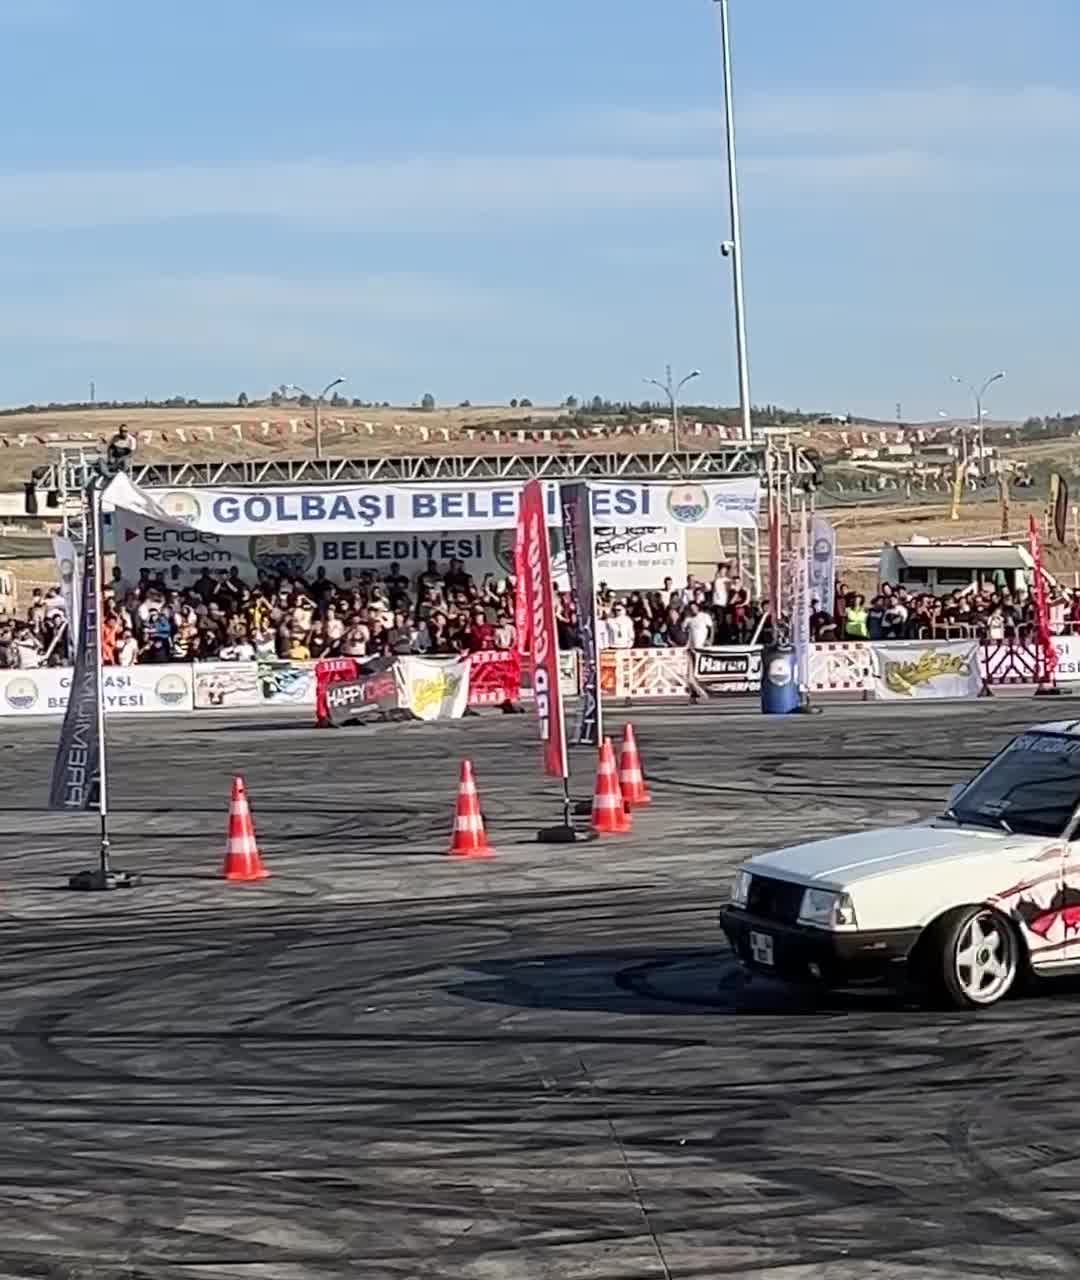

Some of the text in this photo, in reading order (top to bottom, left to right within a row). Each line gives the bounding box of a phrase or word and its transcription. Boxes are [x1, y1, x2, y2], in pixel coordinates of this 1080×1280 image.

[412, 487, 650, 520] BELEİESİ
[144, 547, 232, 561] Reklam
[322, 535, 483, 560] BELEDİYESİ
[327, 684, 365, 708] HAPPY
